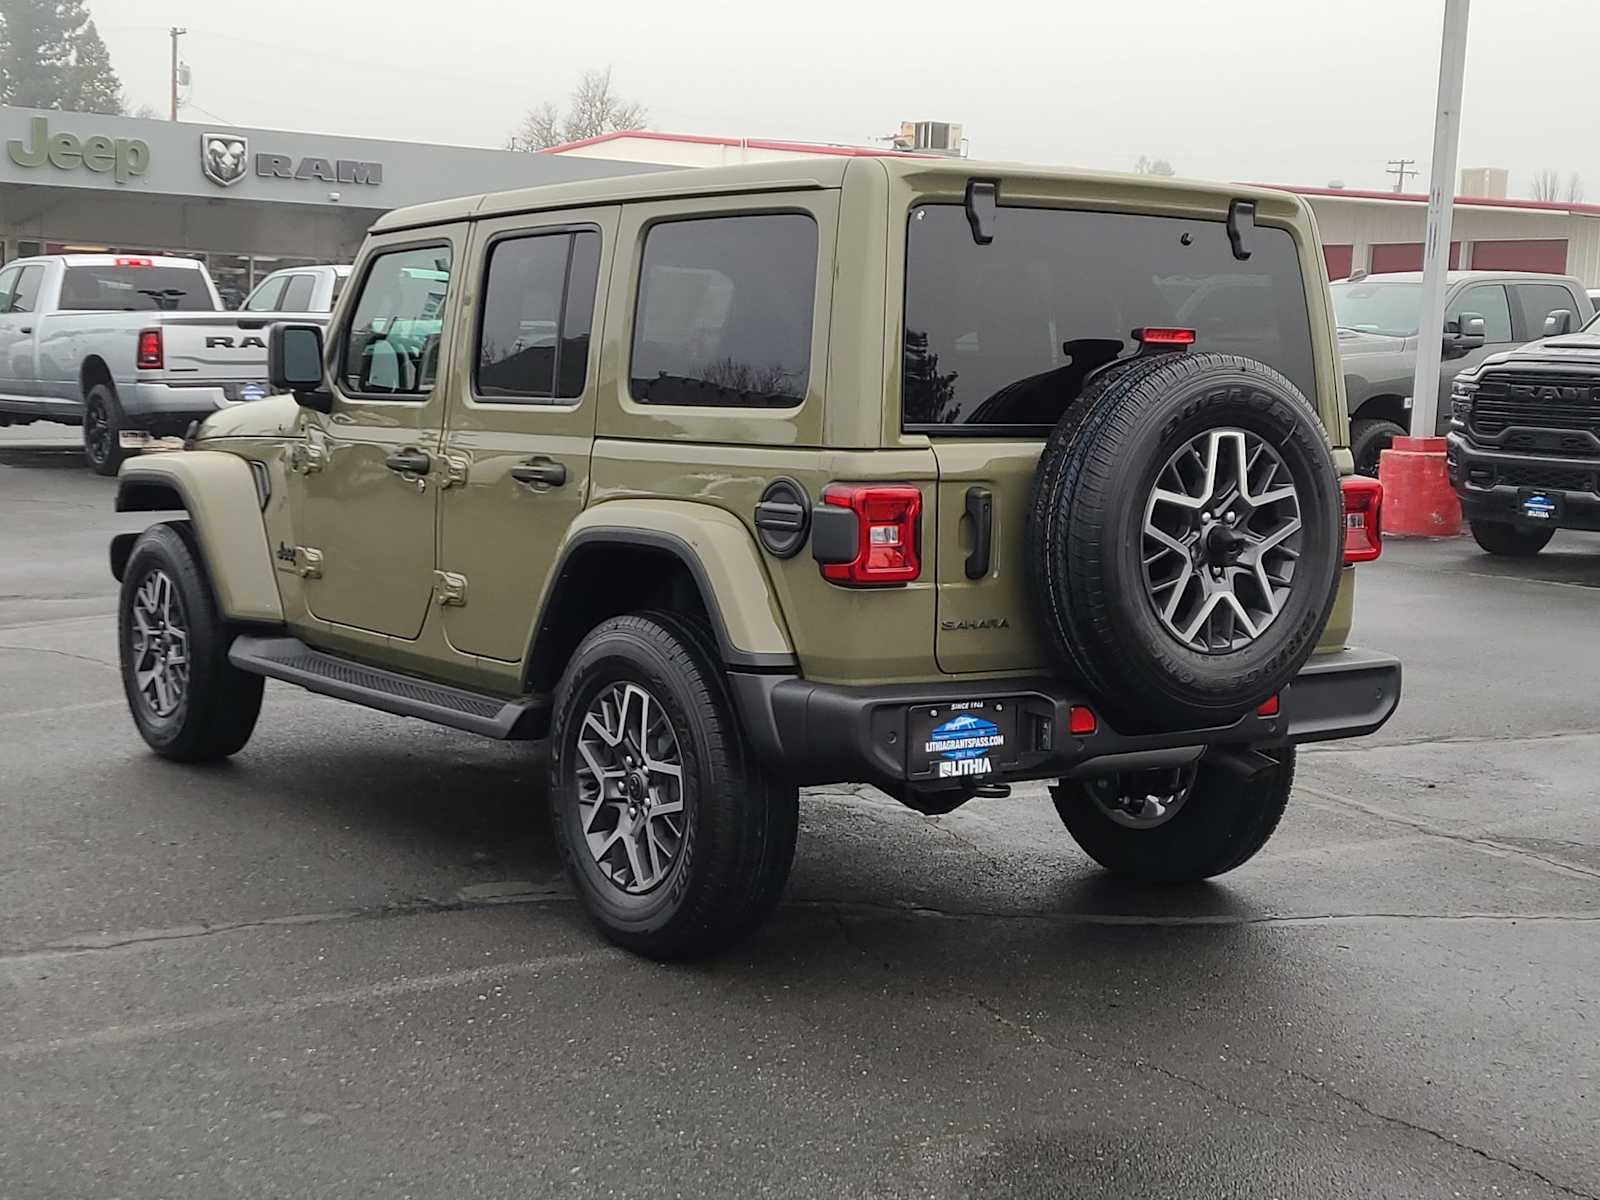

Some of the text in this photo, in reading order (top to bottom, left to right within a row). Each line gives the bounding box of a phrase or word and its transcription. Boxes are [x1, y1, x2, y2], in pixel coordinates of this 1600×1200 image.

[7, 115, 150, 184] Jeep
[256, 152, 383, 185] RAM
[206, 336, 268, 349] RA
[1510, 384, 1590, 400] RAM
[941, 617, 1009, 631] SAHARA
[952, 757, 992, 776] LITHIA
